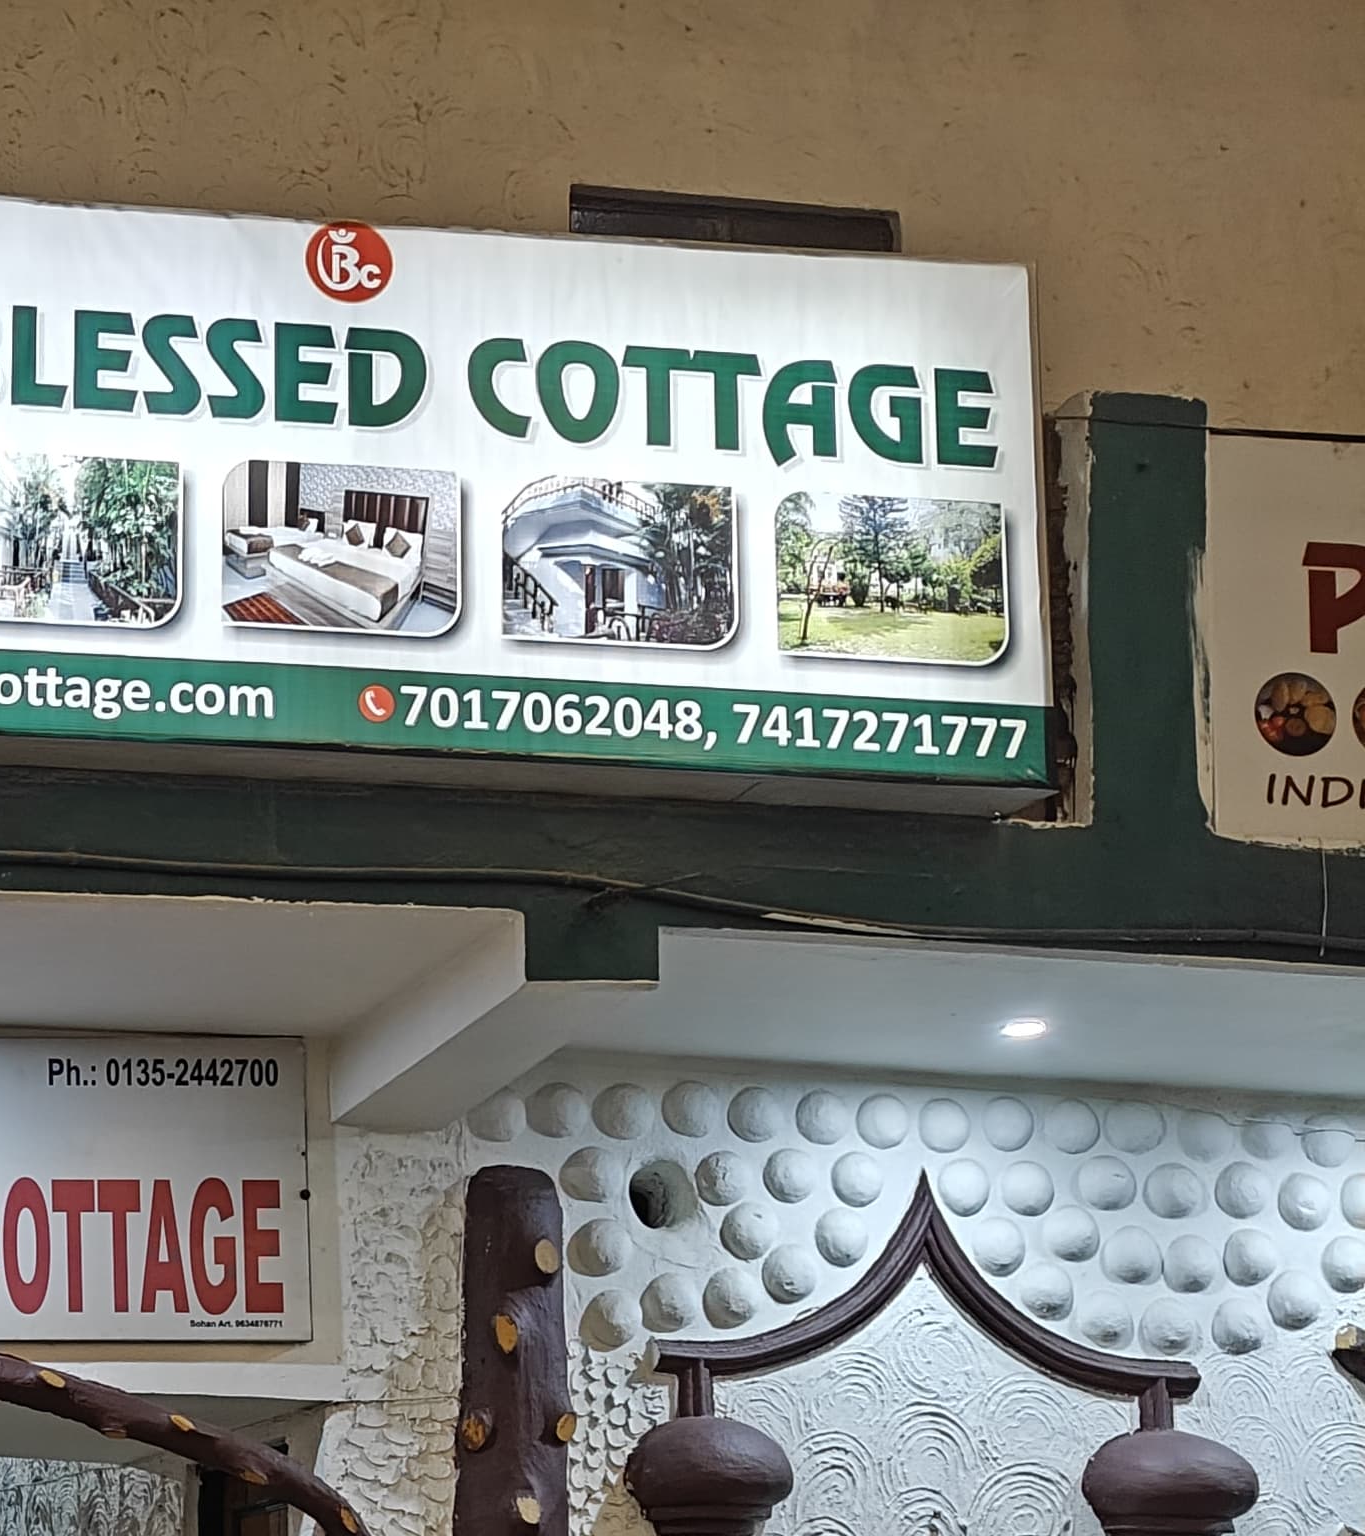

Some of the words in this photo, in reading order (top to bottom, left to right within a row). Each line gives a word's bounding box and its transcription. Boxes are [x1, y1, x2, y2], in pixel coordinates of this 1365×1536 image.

[467, 337, 999, 468] COTTAGE
[398, 684, 717, 749] 7017062048,
[732, 703, 1028, 759] 7417271777
[48, 1058, 97, 1086] Ph.:
[106, 1058, 279, 1087] 0135-2442700
